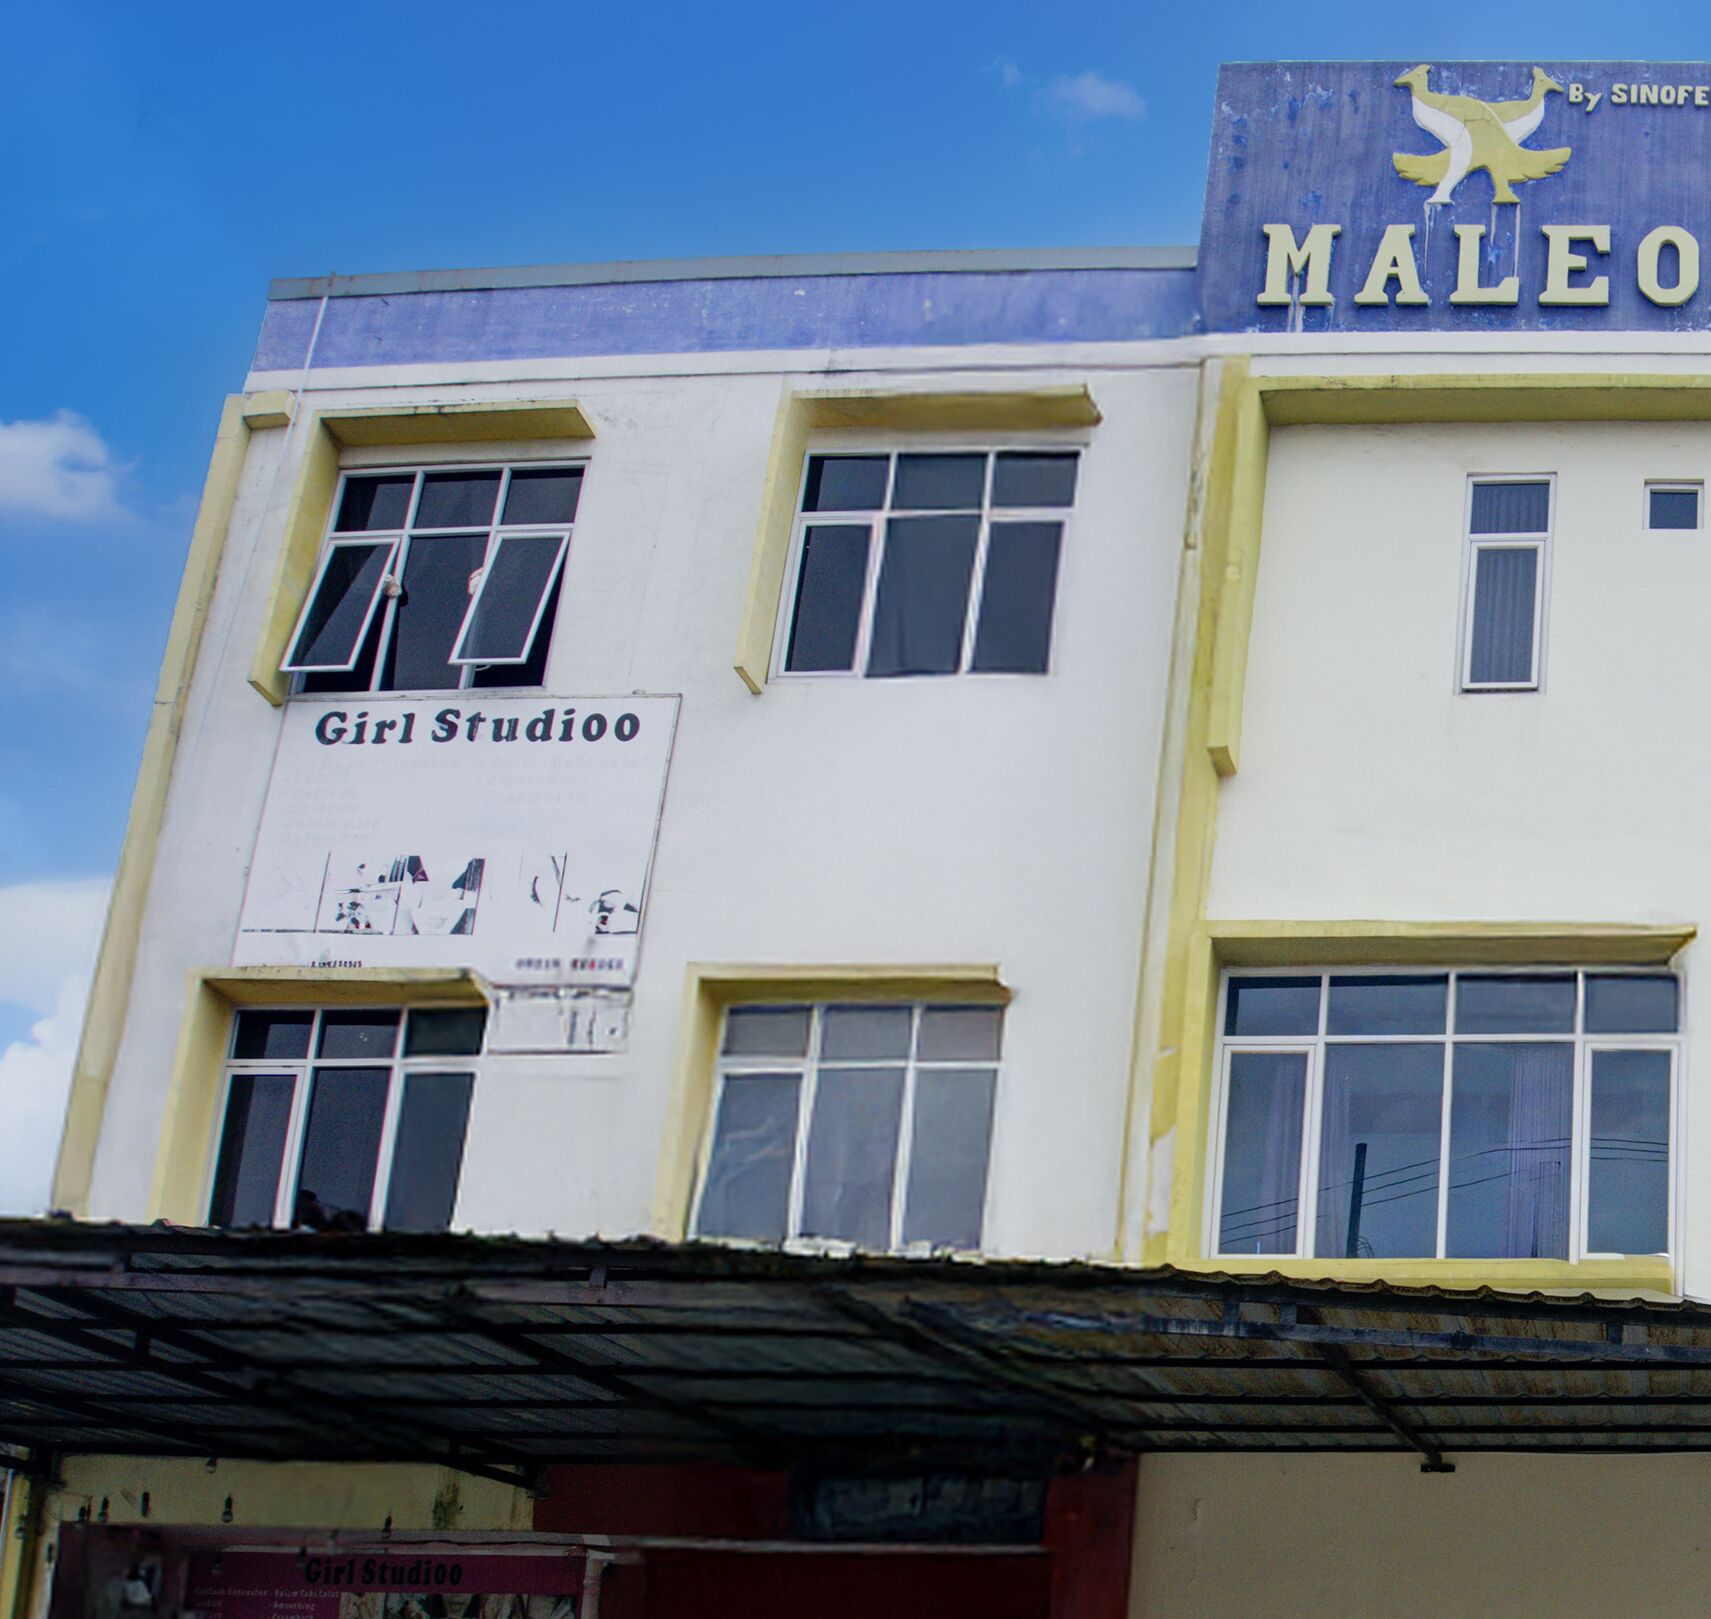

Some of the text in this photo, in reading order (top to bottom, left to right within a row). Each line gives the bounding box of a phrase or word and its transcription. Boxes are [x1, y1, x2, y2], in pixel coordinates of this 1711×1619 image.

[1568, 83, 1603, 112] By
[1256, 223, 1701, 307] MALEO
[314, 708, 641, 746] Girl Studioo
[304, 1557, 463, 1585] Girl Studioo
